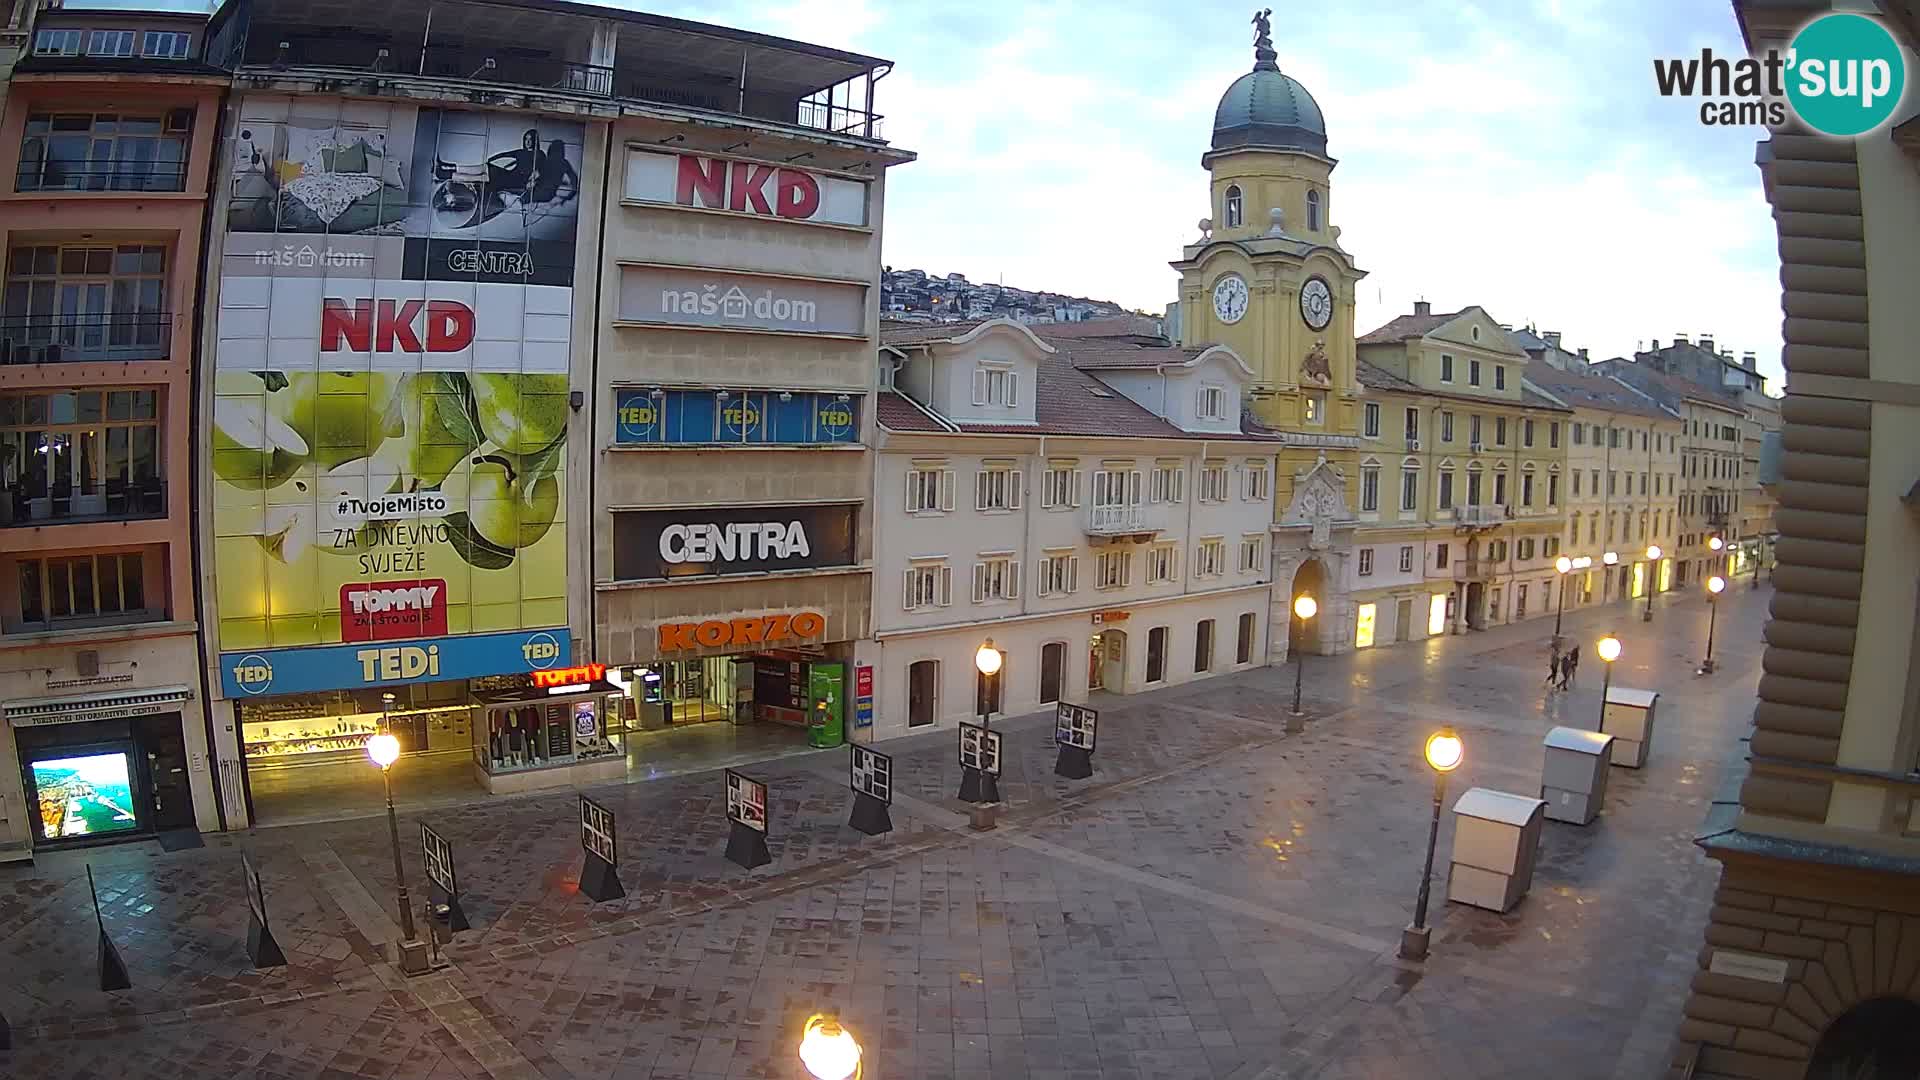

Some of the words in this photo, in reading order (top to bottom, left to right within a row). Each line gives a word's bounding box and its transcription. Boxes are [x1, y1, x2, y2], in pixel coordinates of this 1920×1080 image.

[676, 154, 820, 218] NKD
[255, 245, 294, 266] naš
[319, 246, 365, 267] dom
[448, 249, 535, 275] CENTRA
[661, 284, 719, 315] naš
[753, 289, 816, 323] dom
[321, 298, 476, 352] NKD
[619, 407, 657, 424] TEDi
[723, 408, 759, 425] TEDi
[820, 411, 853, 426] TEDi
[338, 496, 446, 516] #TvojeMisto
[333, 528, 357, 548] ZA
[366, 523, 450, 547] DNEVNO
[658, 521, 810, 563] CENTRA
[359, 546, 426, 575] SVJEŽE
[348, 586, 438, 614] TOMMY
[659, 612, 825, 652] KORZO
[358, 644, 439, 682] TEDi
[522, 642, 560, 660] TEDi
[233, 664, 273, 684] TEDi
